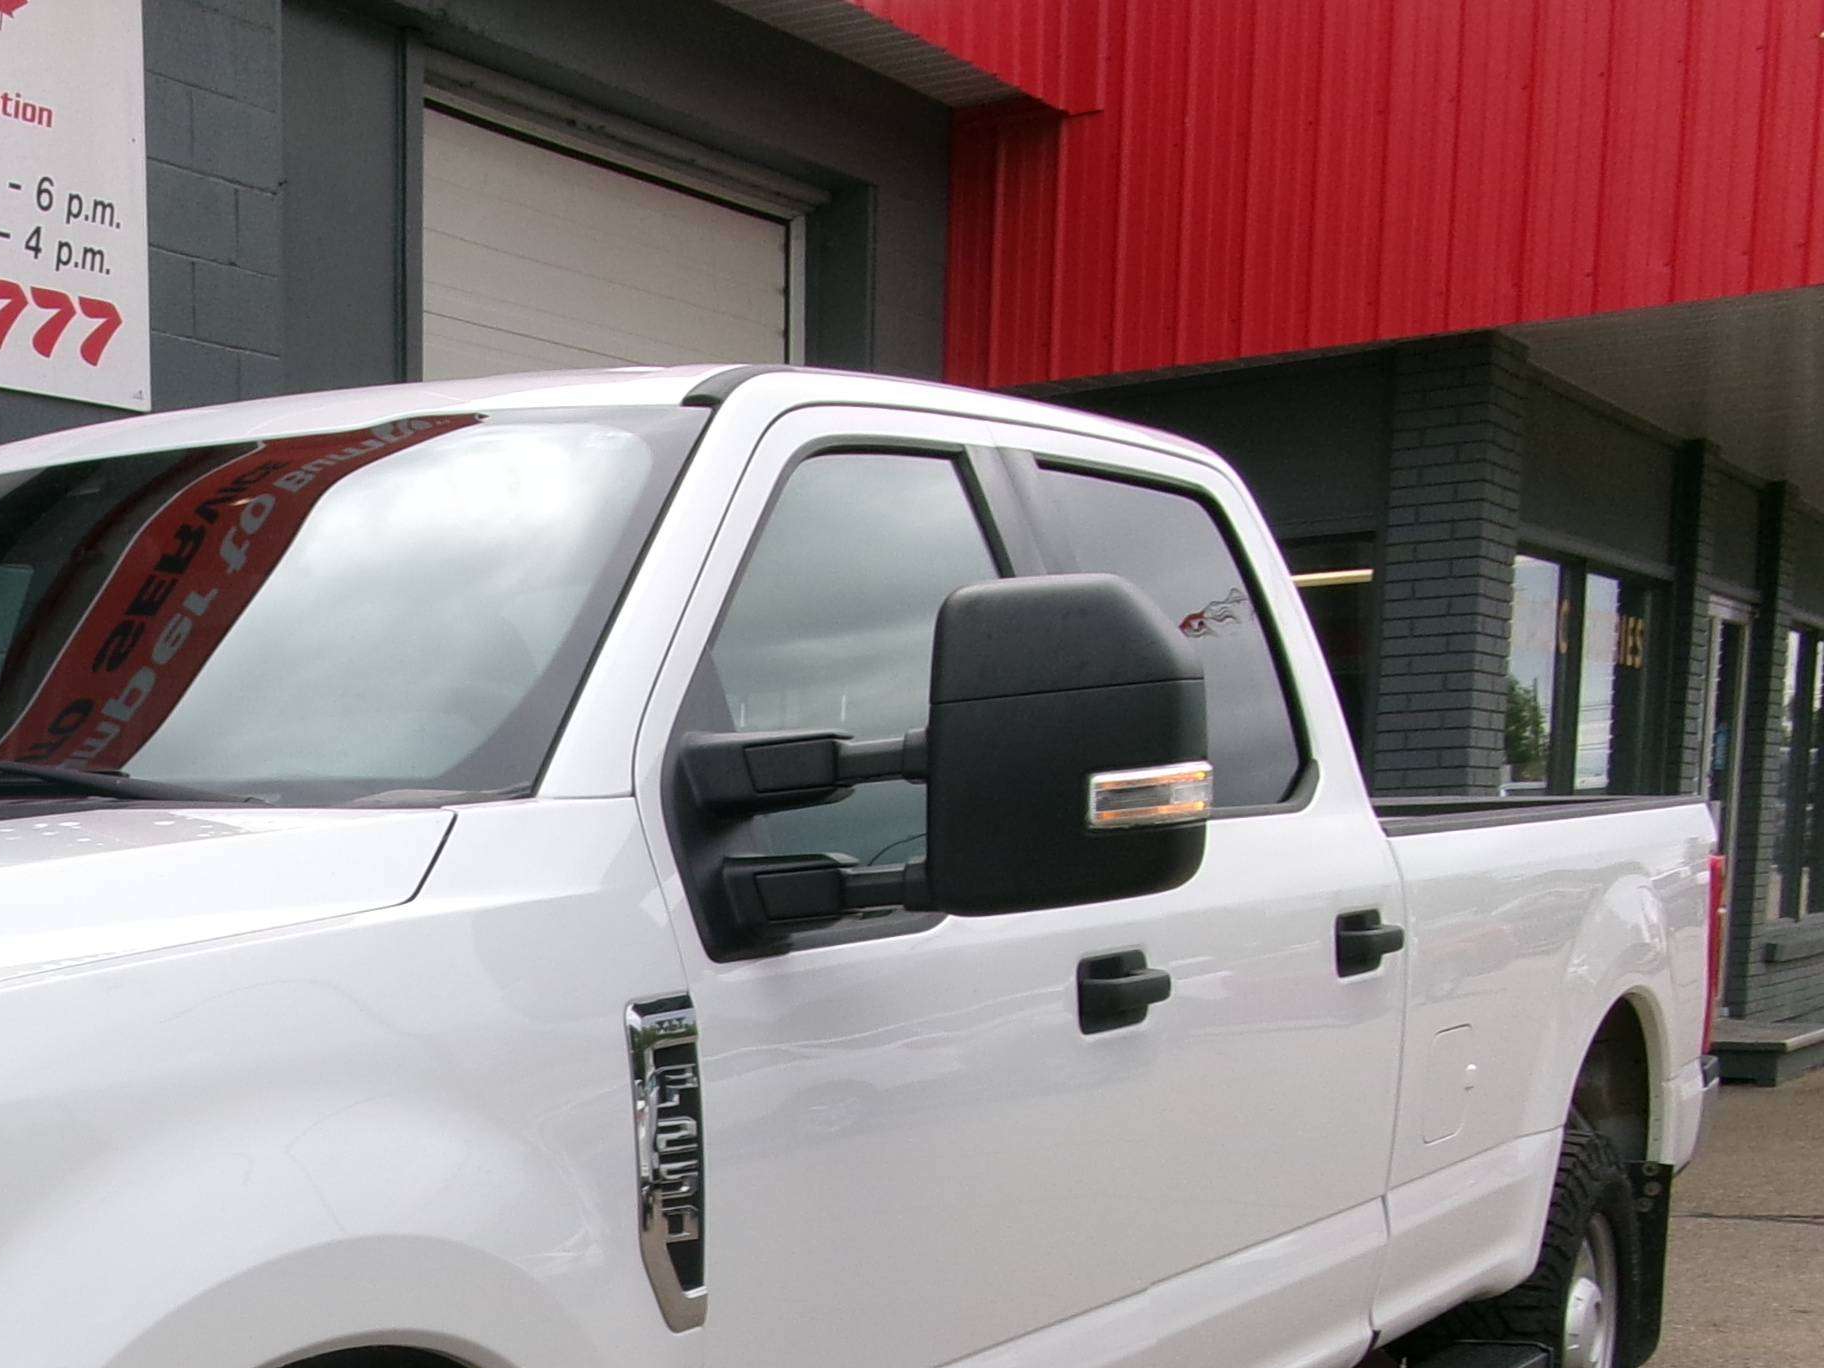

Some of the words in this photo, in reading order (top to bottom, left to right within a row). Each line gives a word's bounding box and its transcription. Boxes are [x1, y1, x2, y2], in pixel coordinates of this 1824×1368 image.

[36, 176, 54, 212] 6
[65, 193, 121, 229] p.m.
[24, 226, 42, 260] 4
[55, 240, 111, 275] p.m.
